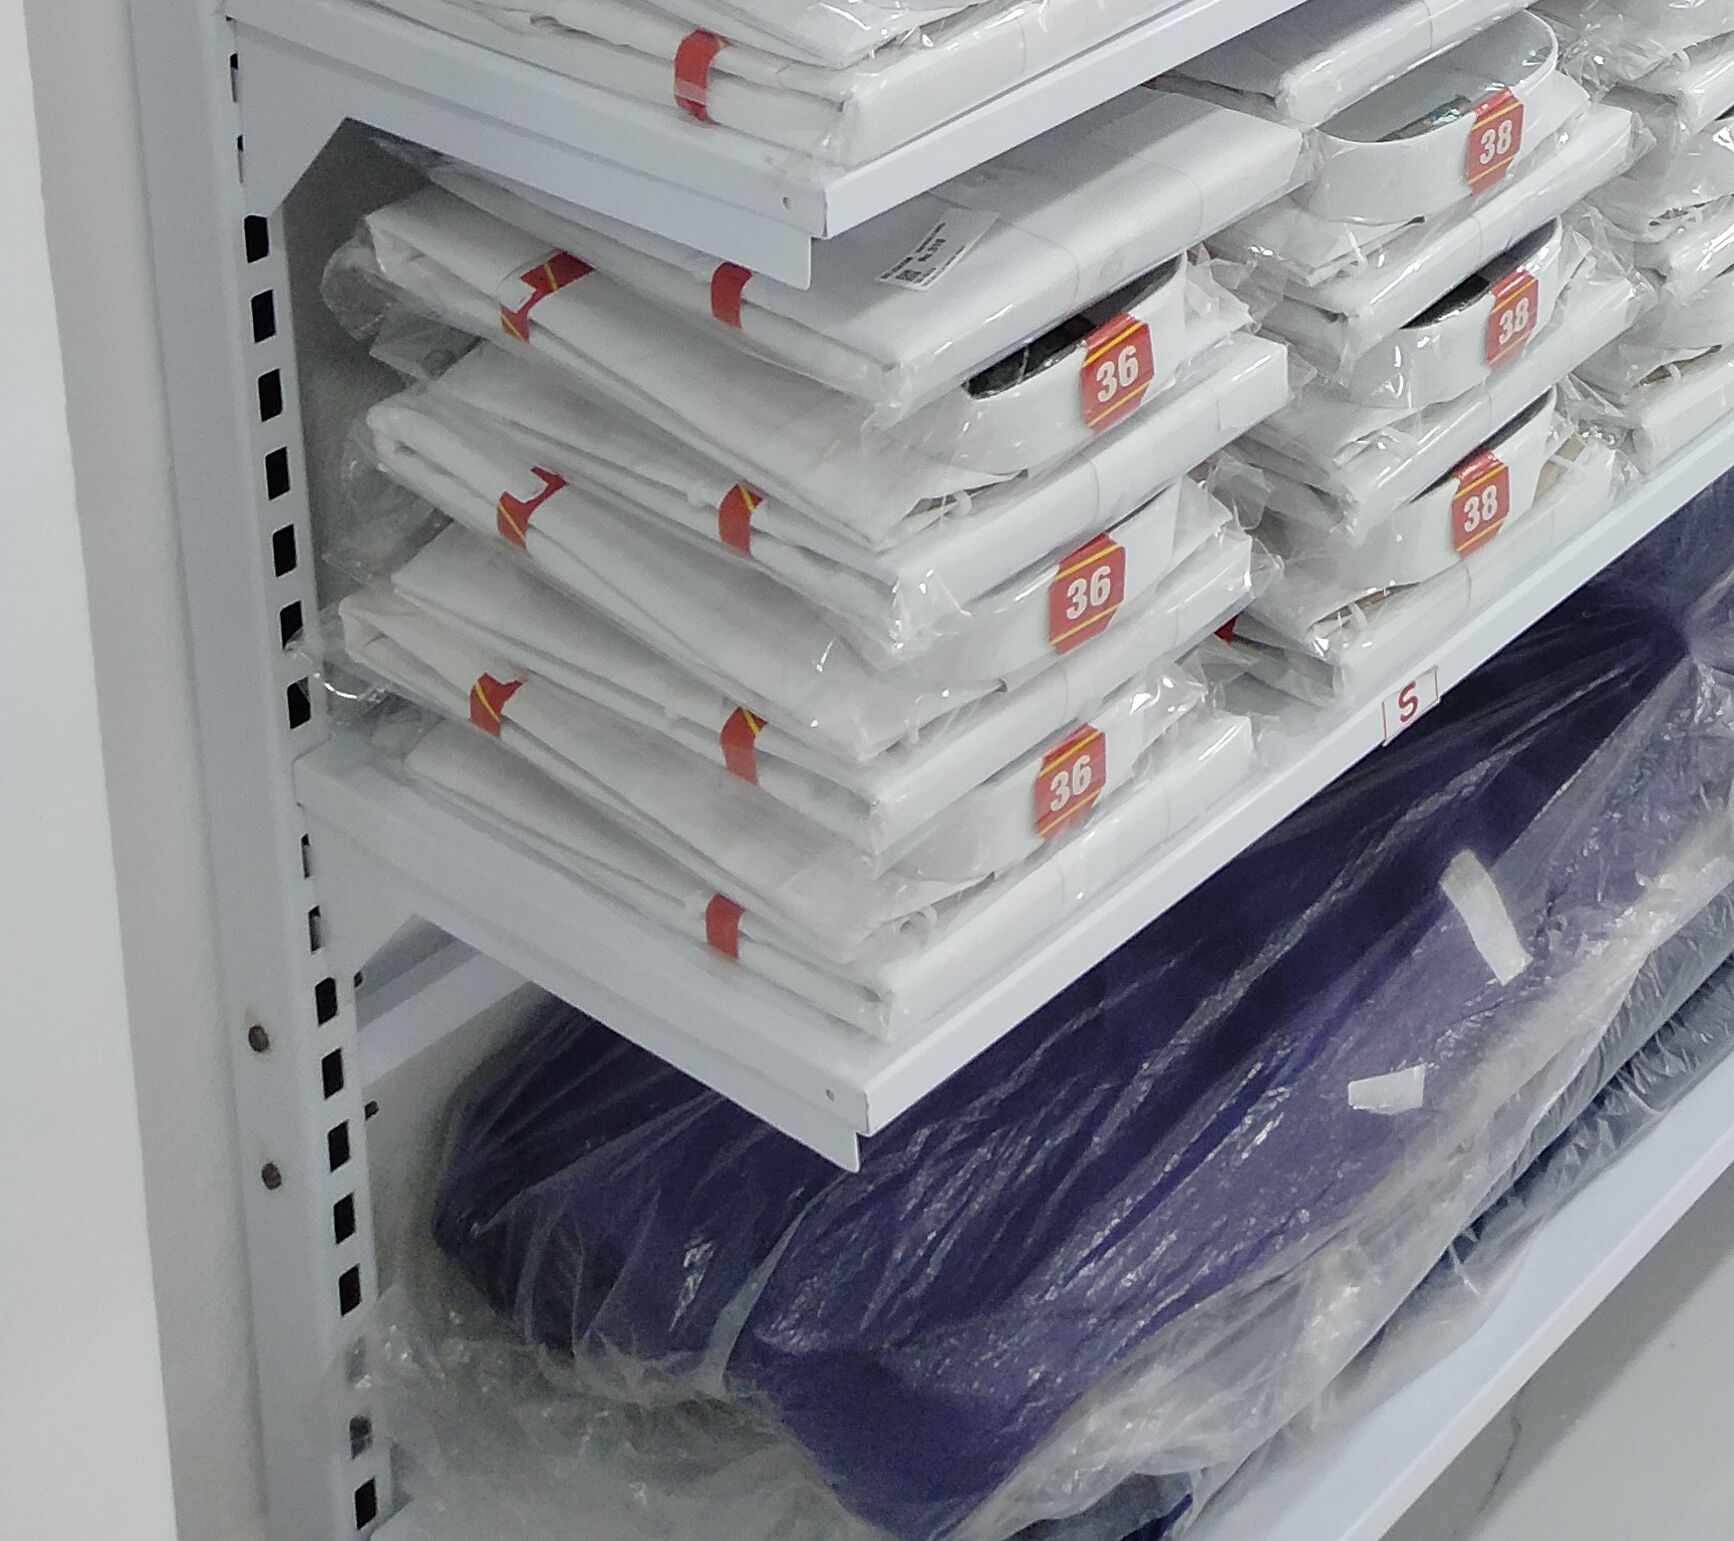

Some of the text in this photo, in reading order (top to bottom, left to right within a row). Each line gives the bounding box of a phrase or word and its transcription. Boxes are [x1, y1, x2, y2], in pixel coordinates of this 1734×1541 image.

[1480, 119, 1513, 164] 38
[1499, 297, 1530, 345] 38
[1096, 345, 1139, 402] 36
[1463, 485, 1497, 533] 38
[1066, 565, 1111, 620] 36
[1398, 681, 1418, 722] S
[1050, 755, 1092, 811] 36
